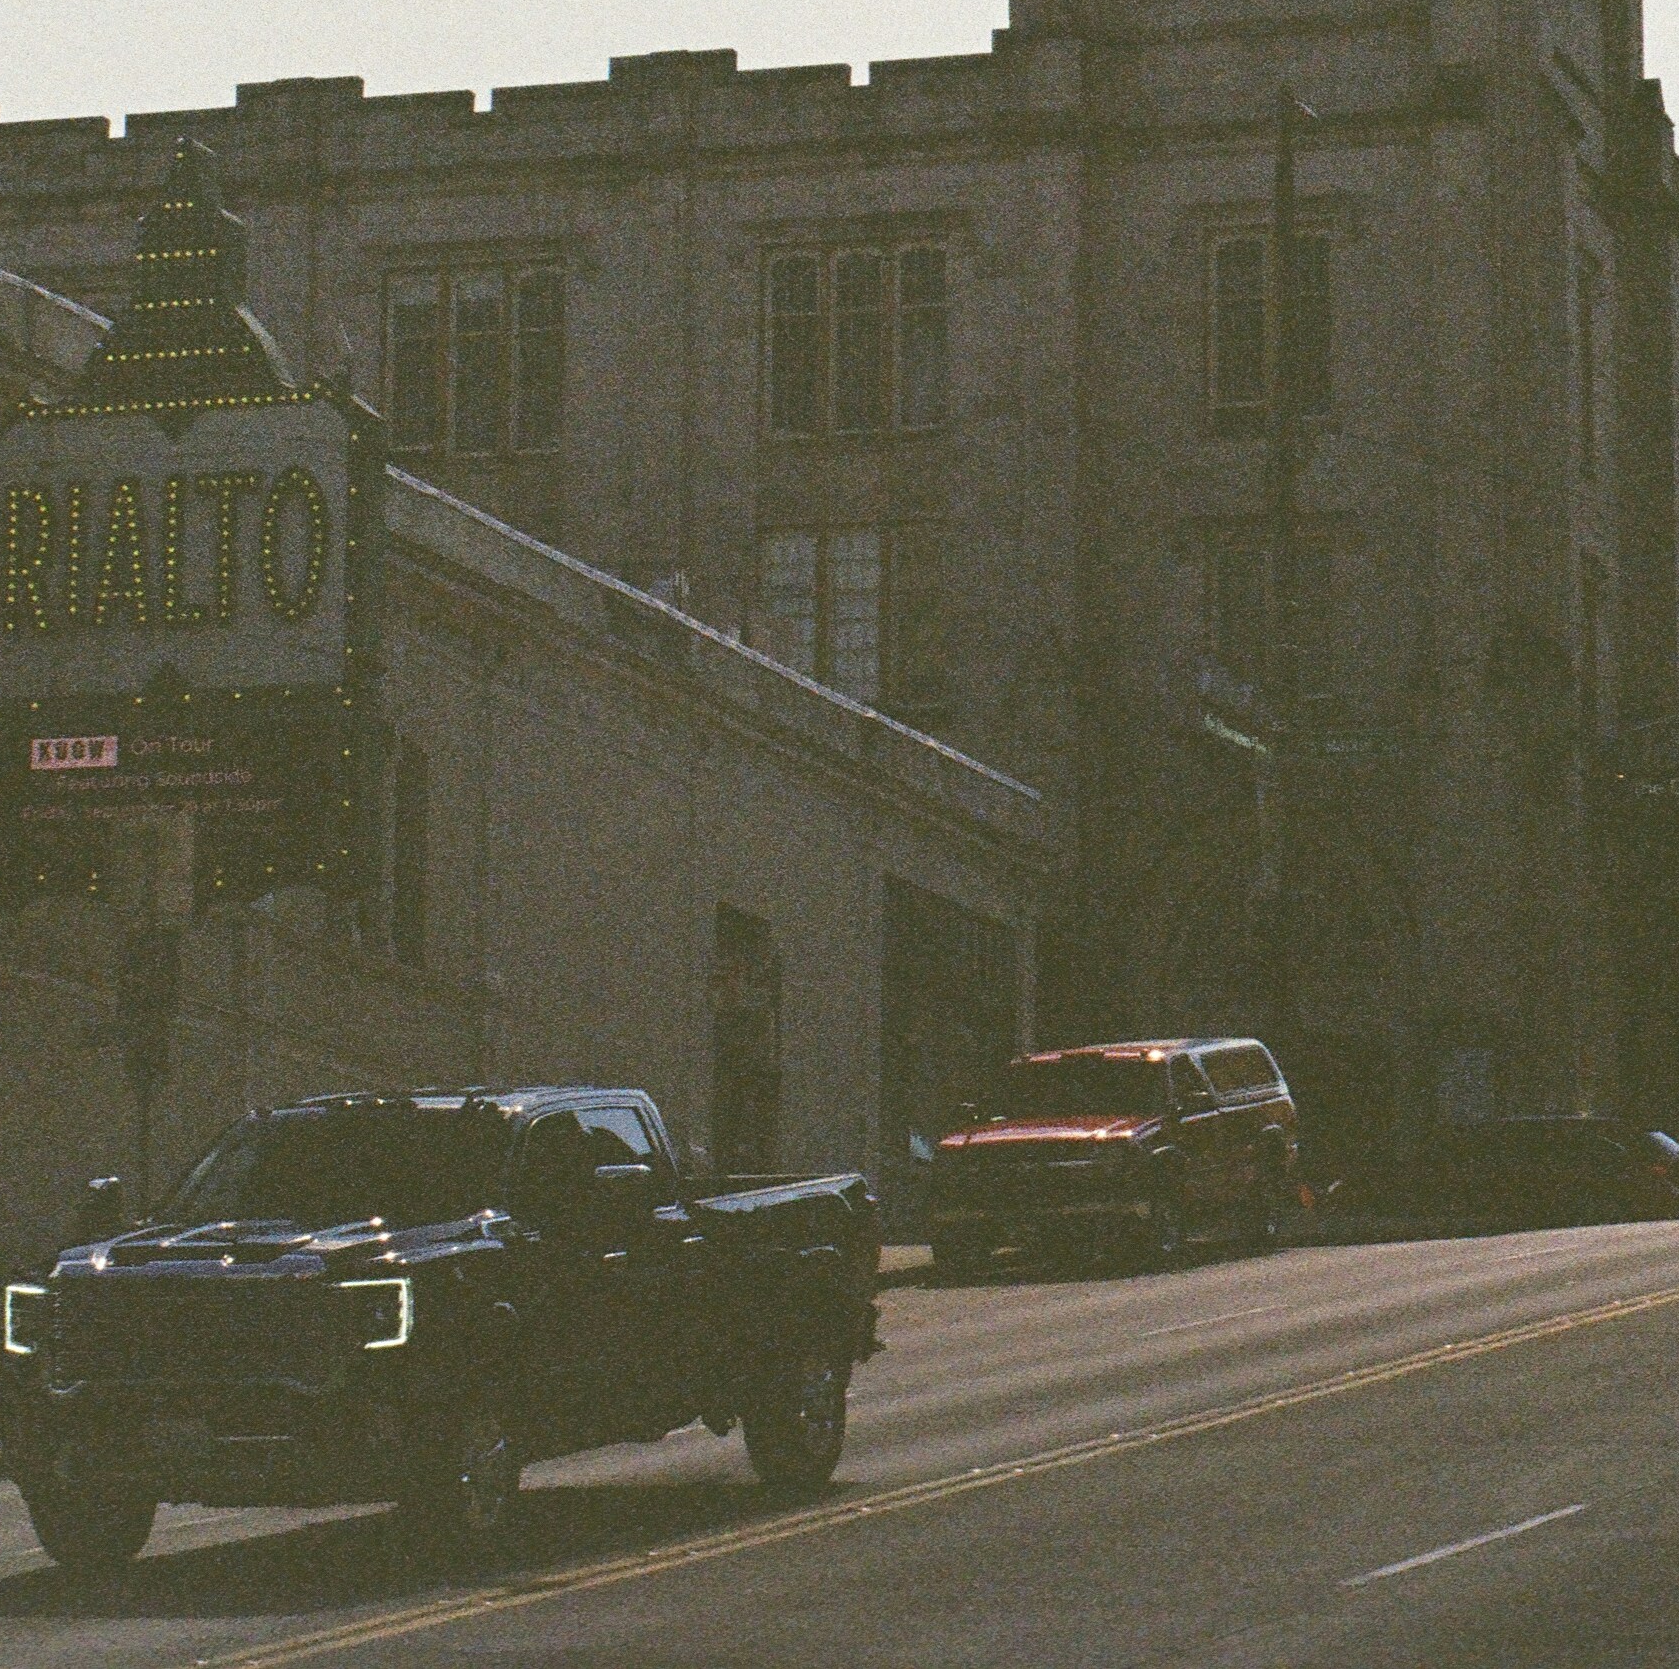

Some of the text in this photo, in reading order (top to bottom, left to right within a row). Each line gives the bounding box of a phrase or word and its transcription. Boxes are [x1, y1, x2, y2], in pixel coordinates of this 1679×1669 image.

[6, 466, 326, 631] RIALTO
[130, 738, 162, 755] On
[169, 735, 214, 753] Tour
